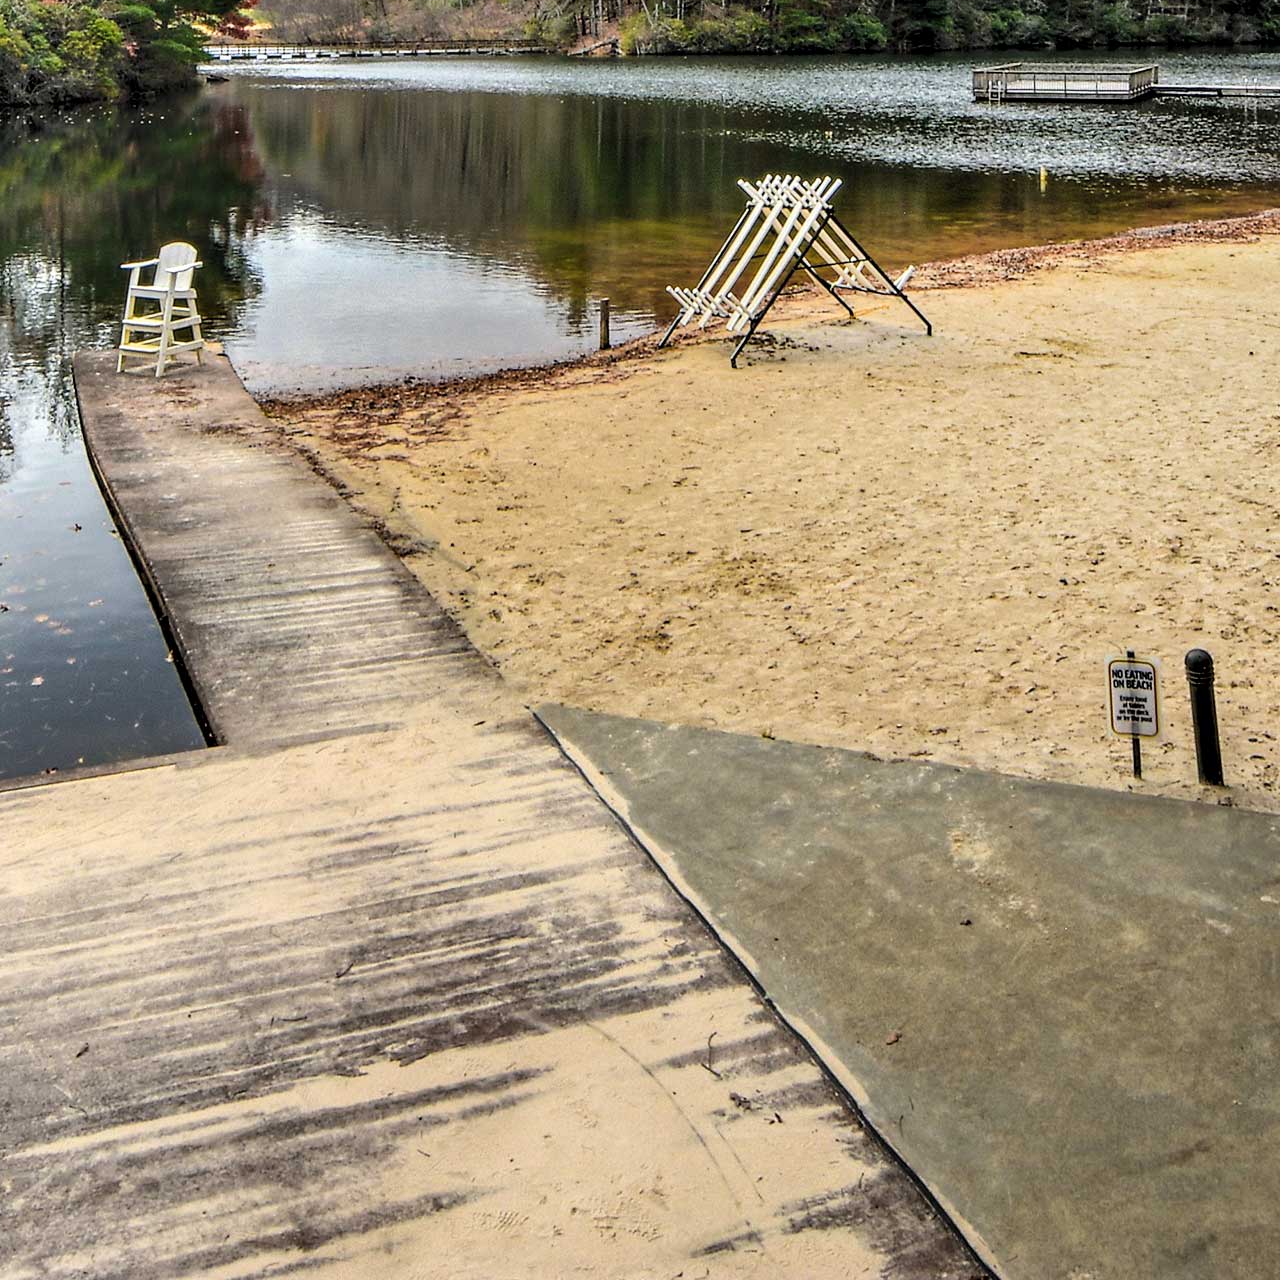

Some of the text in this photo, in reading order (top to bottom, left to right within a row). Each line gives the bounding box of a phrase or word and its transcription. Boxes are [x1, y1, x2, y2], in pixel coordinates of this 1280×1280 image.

[1112, 669, 1153, 681] NO EATING
[1113, 679, 1153, 690] ON BEACH
